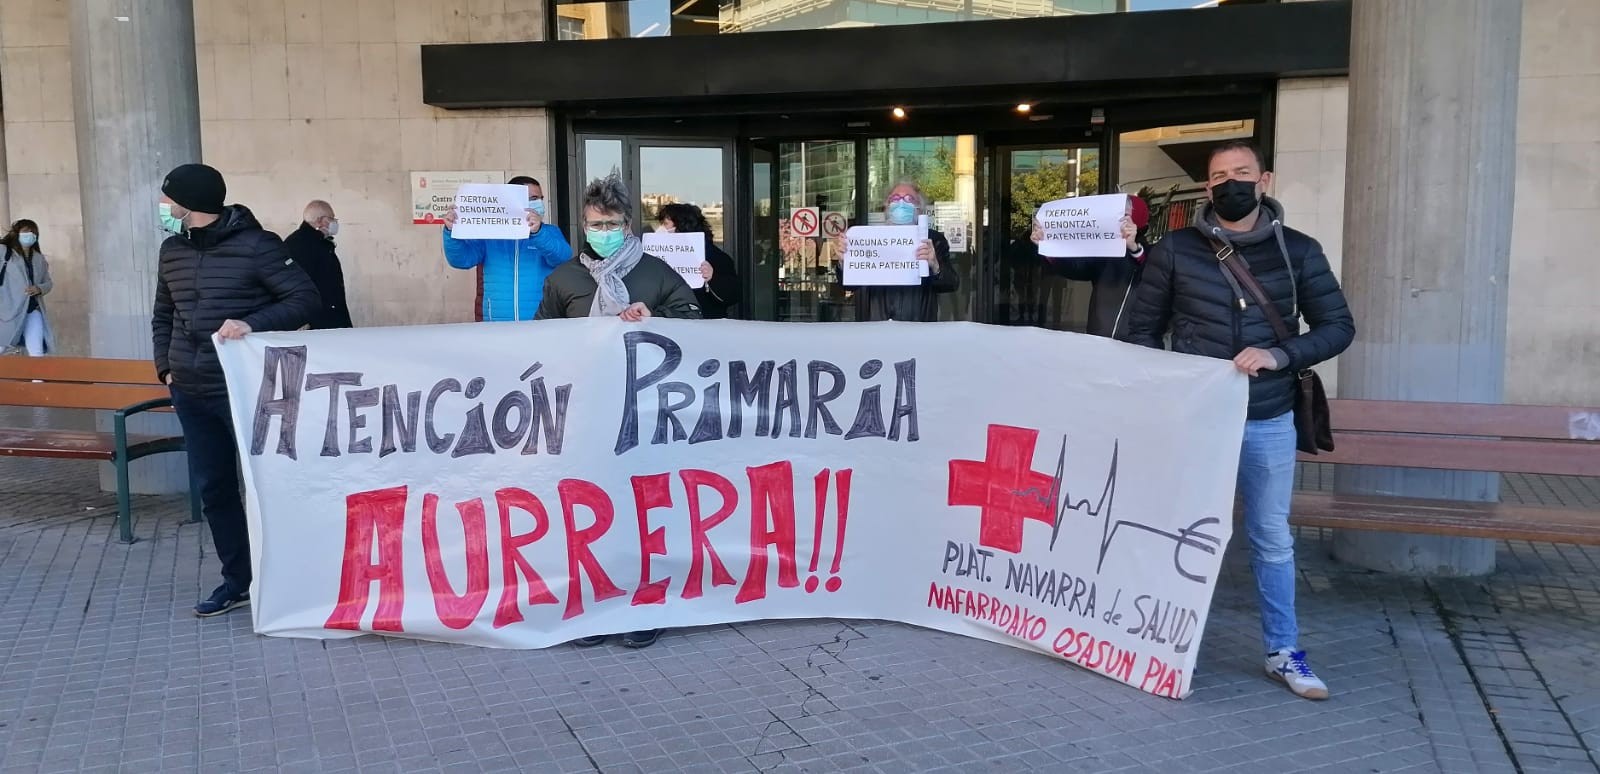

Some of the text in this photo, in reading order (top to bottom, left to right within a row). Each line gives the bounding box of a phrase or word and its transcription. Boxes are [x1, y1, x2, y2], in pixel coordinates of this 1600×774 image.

[460, 195, 499, 204] TXERTOAK
[1045, 208, 1090, 217] TXERTOAK
[461, 217, 522, 226] PATENTERIK EZ
[1046, 232, 1116, 241] PATENTERIK EZ
[849, 238, 914, 247] VACUNAS PARA
[675, 245, 695, 253] PARA
[849, 261, 920, 270] FUERA PATENTES
[323, 460, 853, 632] AURRERA!!
[942, 540, 1198, 653] PLAT. NAVARRA de SALUD
[1053, 628, 1137, 685] OSASUN
